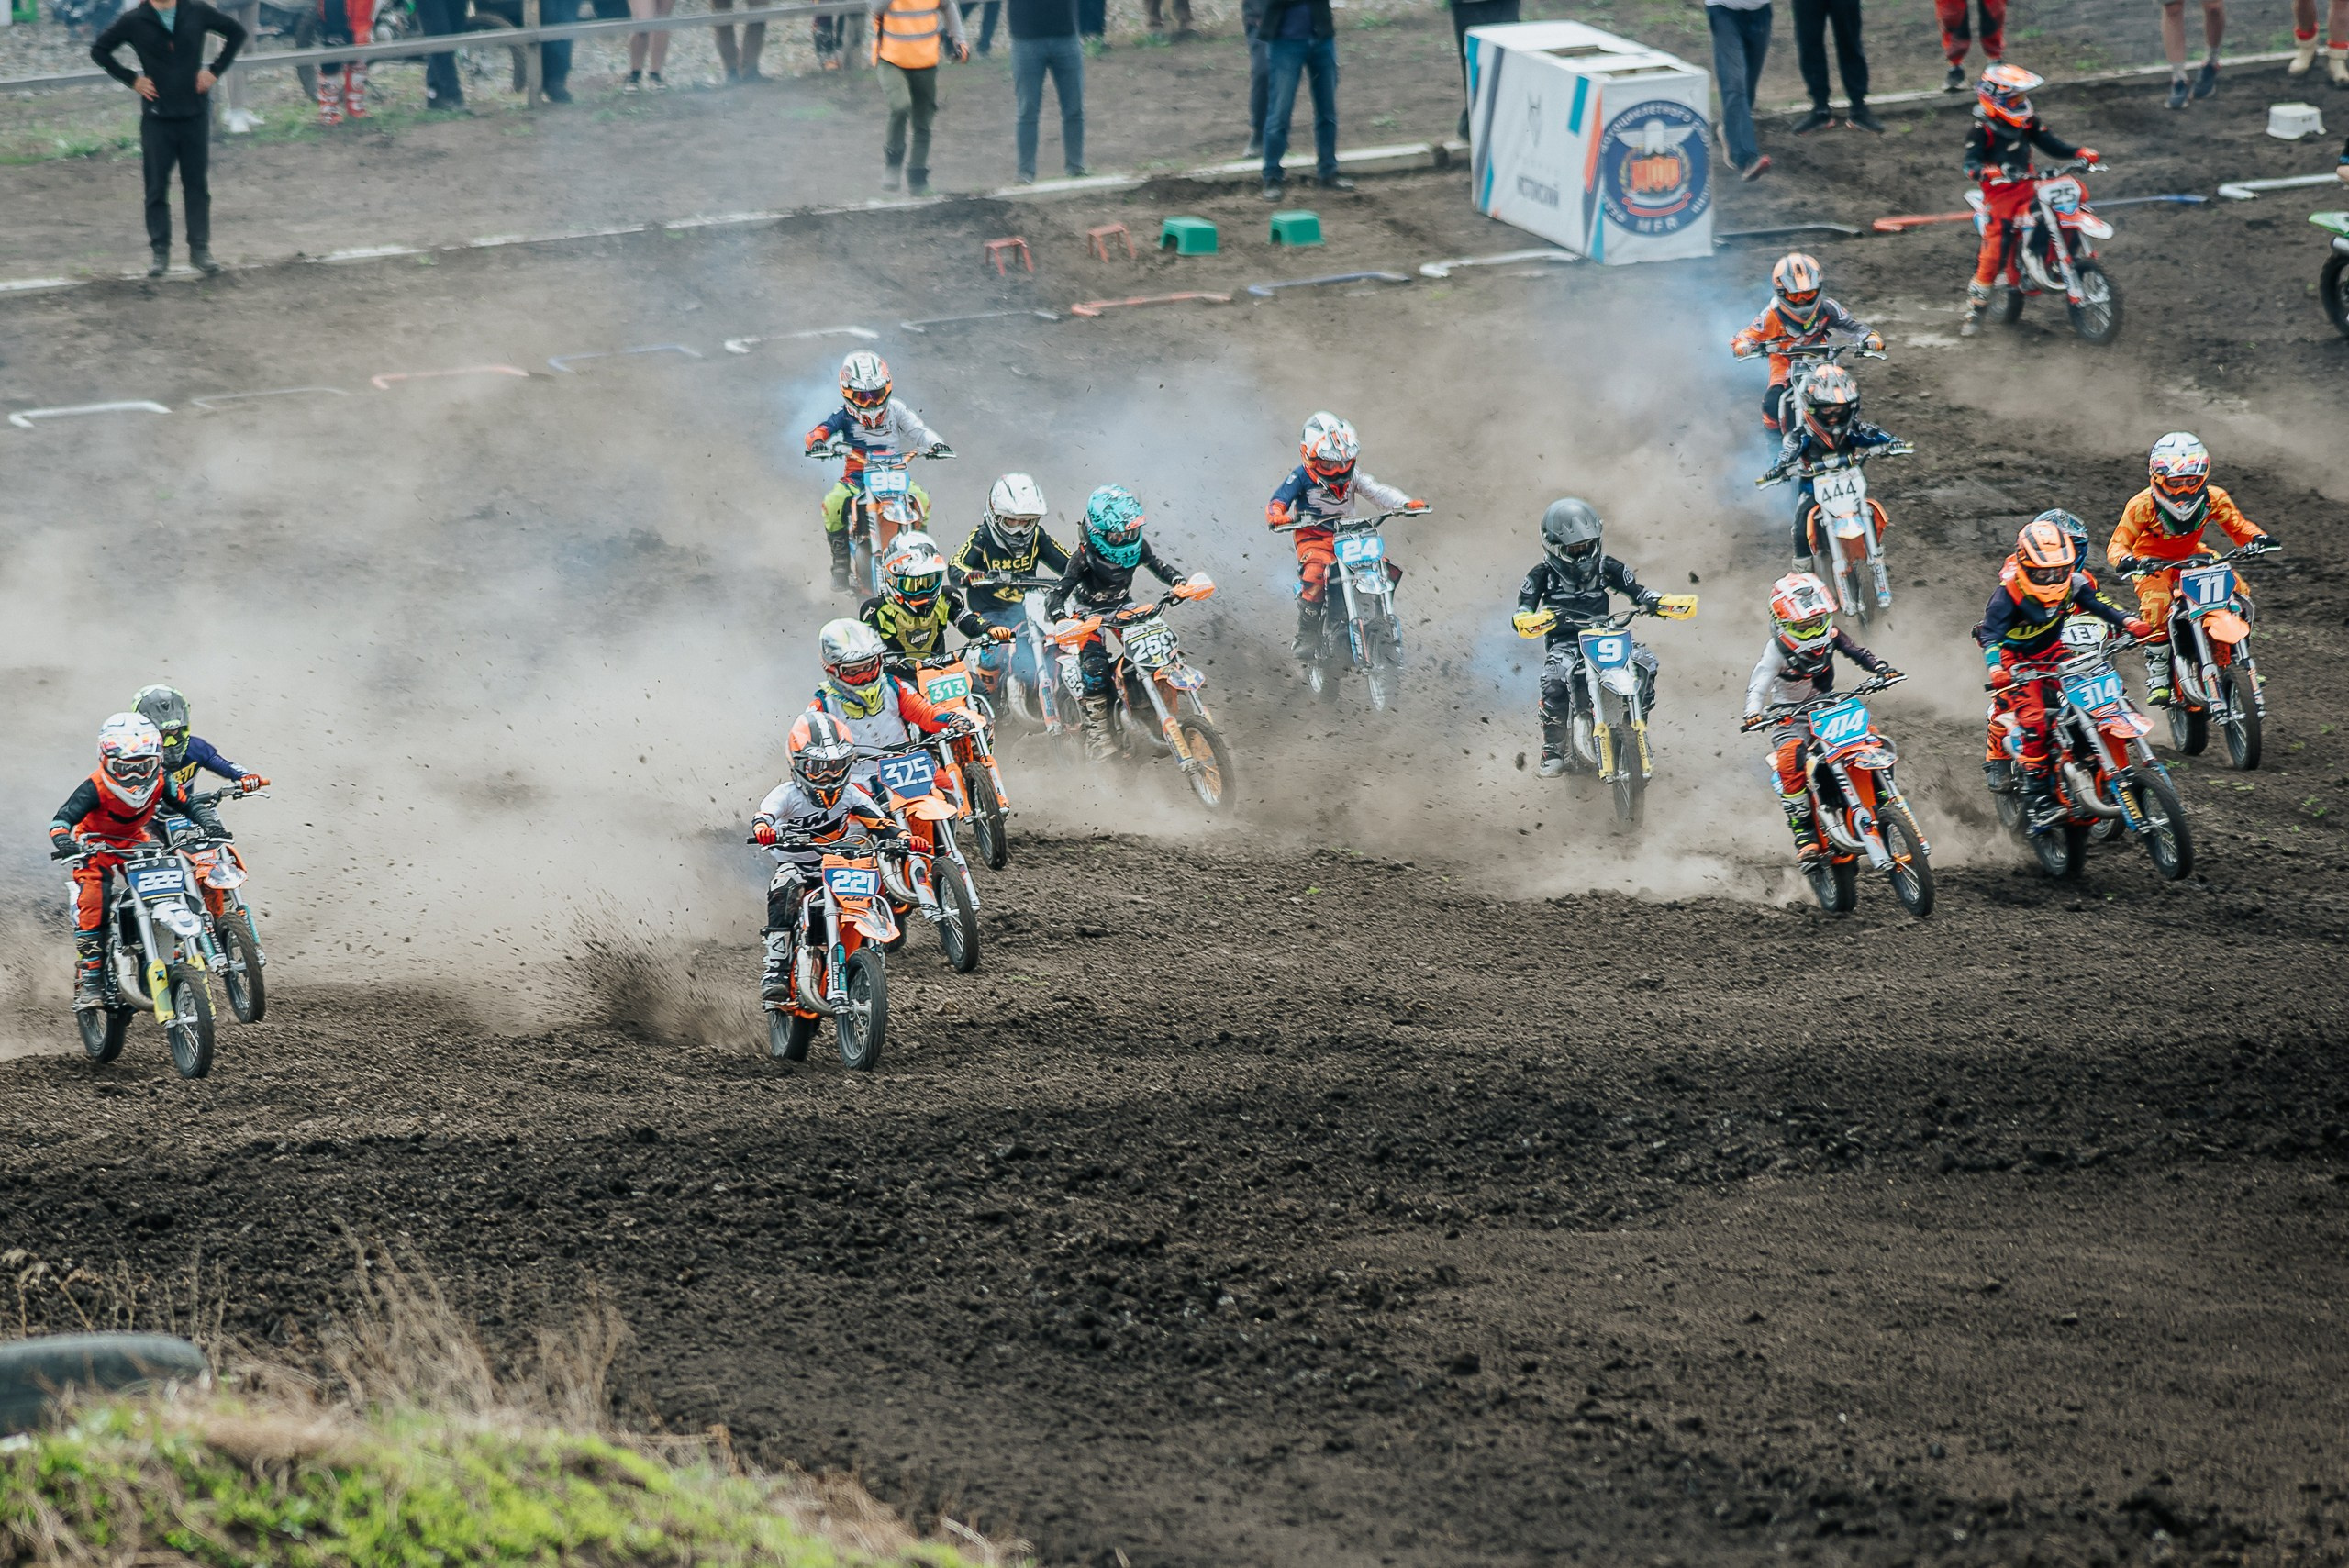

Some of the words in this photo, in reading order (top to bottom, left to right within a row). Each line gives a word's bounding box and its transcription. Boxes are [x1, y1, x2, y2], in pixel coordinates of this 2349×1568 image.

[2049, 187, 2076, 204] 25
[870, 472, 907, 493] 99
[1822, 480, 1856, 503] 444
[1342, 539, 1379, 562] 24
[2197, 574, 2225, 605] 11
[1598, 639, 1622, 662] 9
[931, 680, 966, 700] 313
[2079, 678, 2120, 710] 314
[1822, 708, 1865, 740] 414
[883, 756, 932, 789] 325
[138, 870, 184, 893] 222
[831, 870, 875, 895] 221
